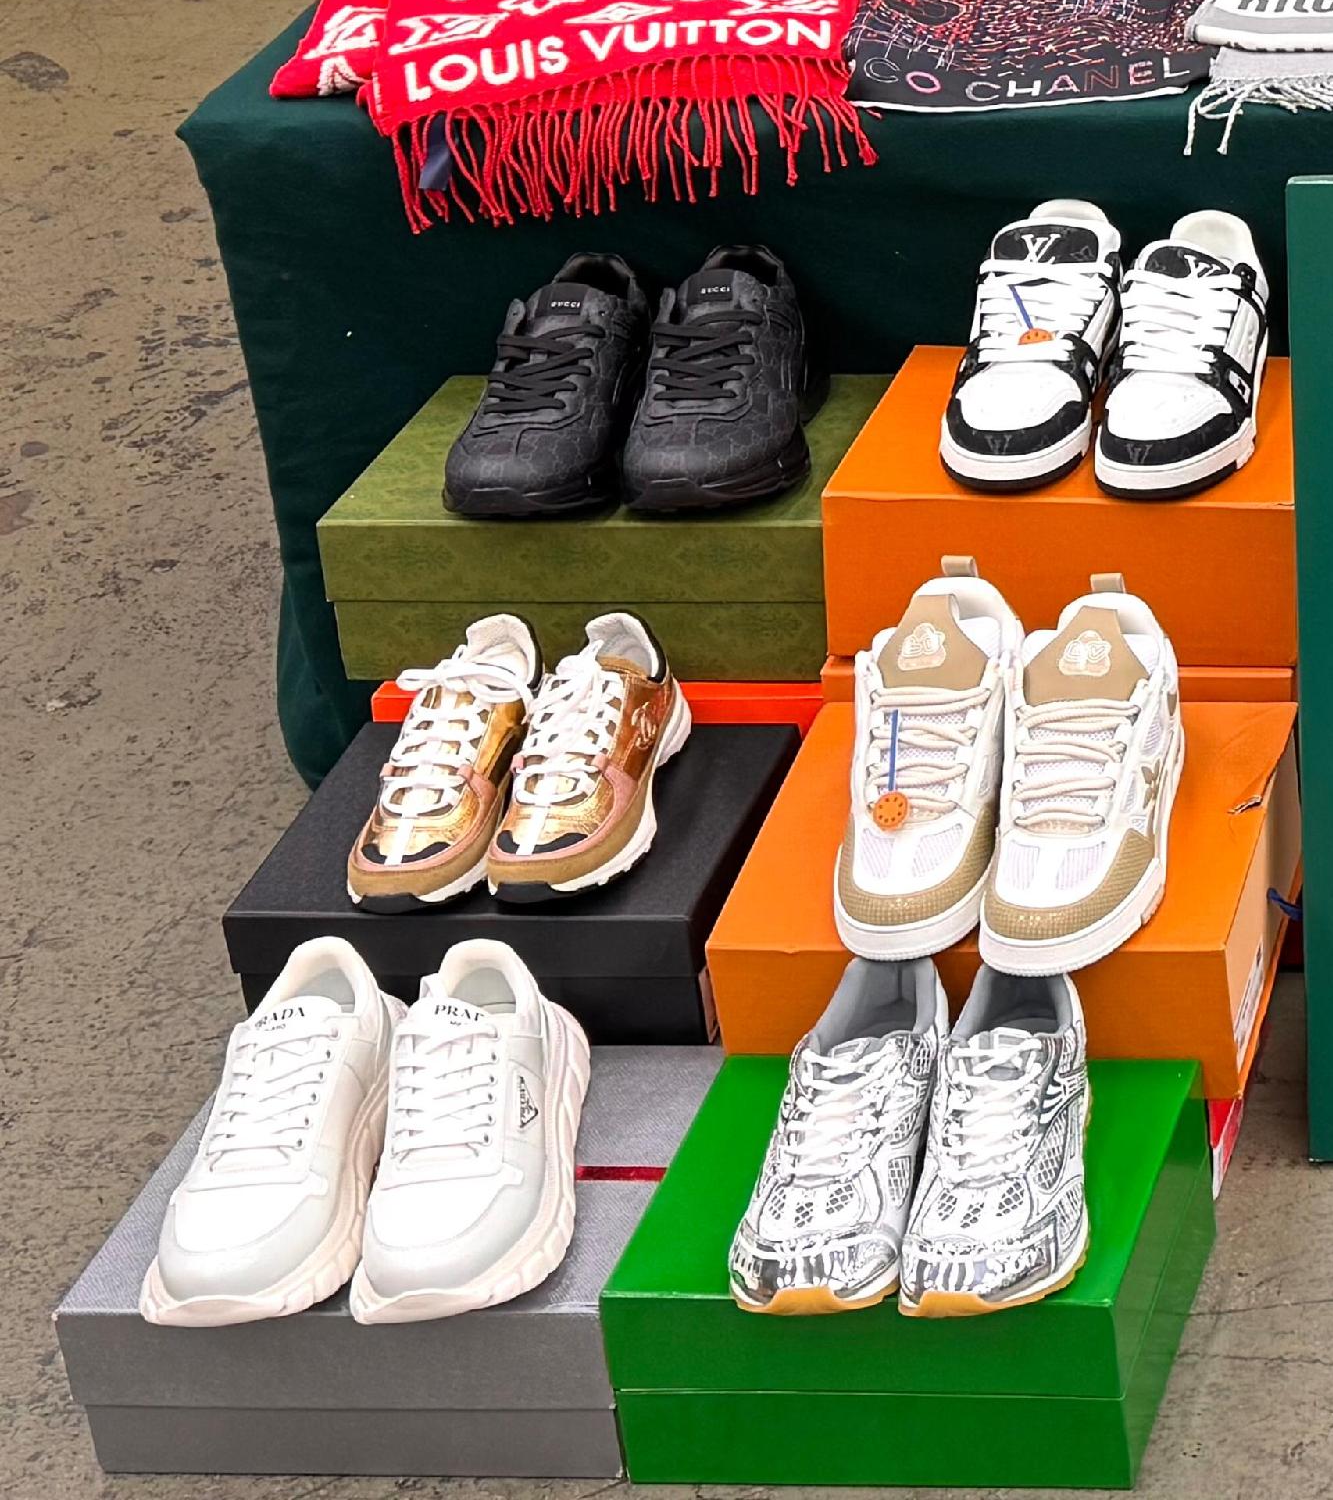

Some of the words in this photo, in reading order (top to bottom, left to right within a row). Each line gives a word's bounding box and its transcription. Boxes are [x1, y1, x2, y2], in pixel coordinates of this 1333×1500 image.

[404, 36, 569, 103] LOUIS
[579, 19, 832, 61] VUITTON
[965, 56, 1191, 102] CHANEL
